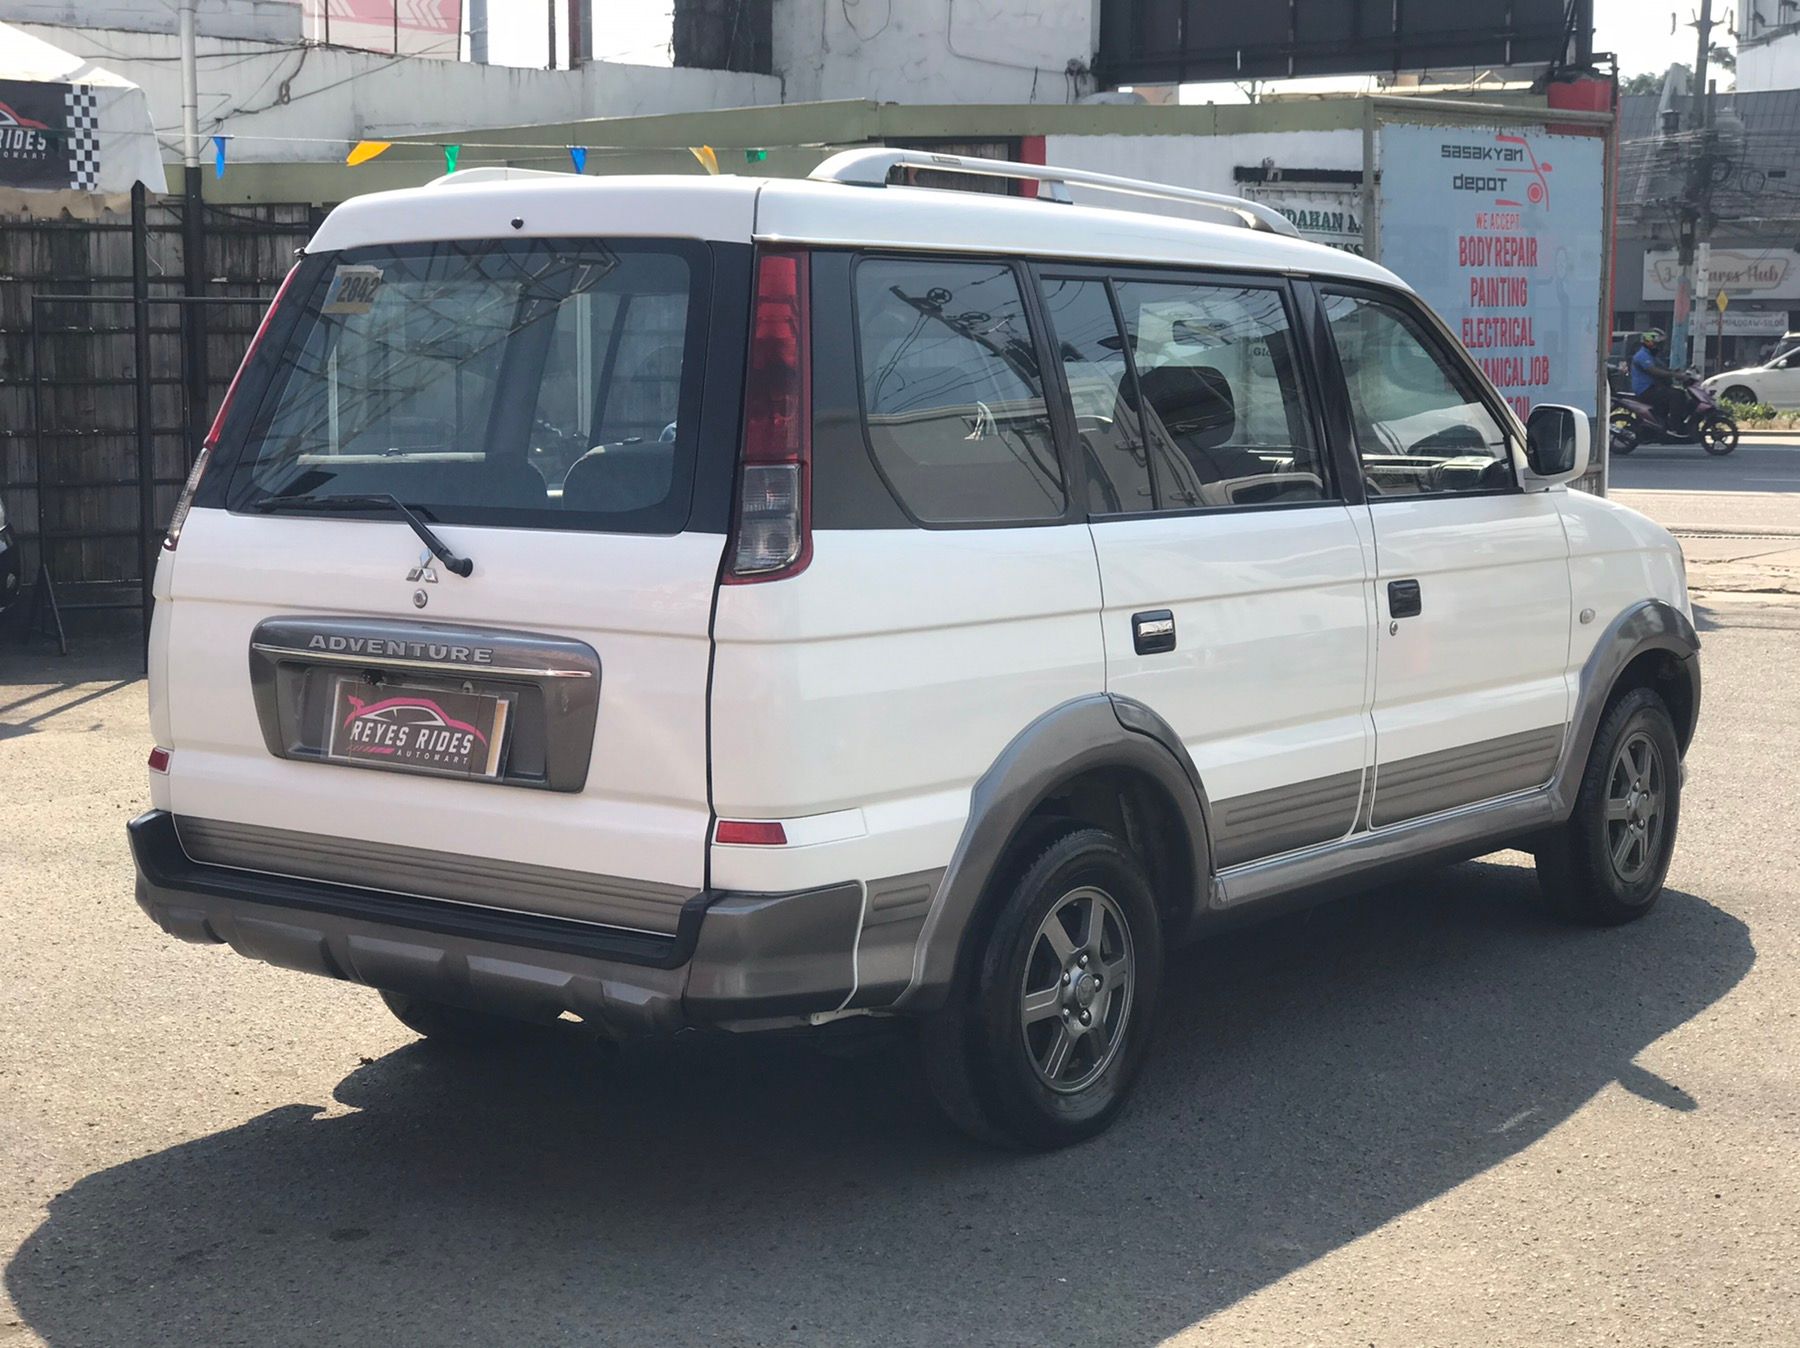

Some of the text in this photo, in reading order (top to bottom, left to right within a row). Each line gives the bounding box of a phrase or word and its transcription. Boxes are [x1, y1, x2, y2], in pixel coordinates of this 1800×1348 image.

[3, 151, 46, 160] OMART
[1476, 213, 1488, 229] WE
[1460, 236, 1537, 267] BODY REPAIR
[1470, 277, 1527, 307] PAINTING
[1462, 318, 1535, 348] ELECTRICAL
[1528, 356, 1549, 385] JOB
[308, 634, 493, 663] ADVENTURE
[350, 720, 474, 754] REYES RIDES
[397, 749, 469, 764] AUTOMART
